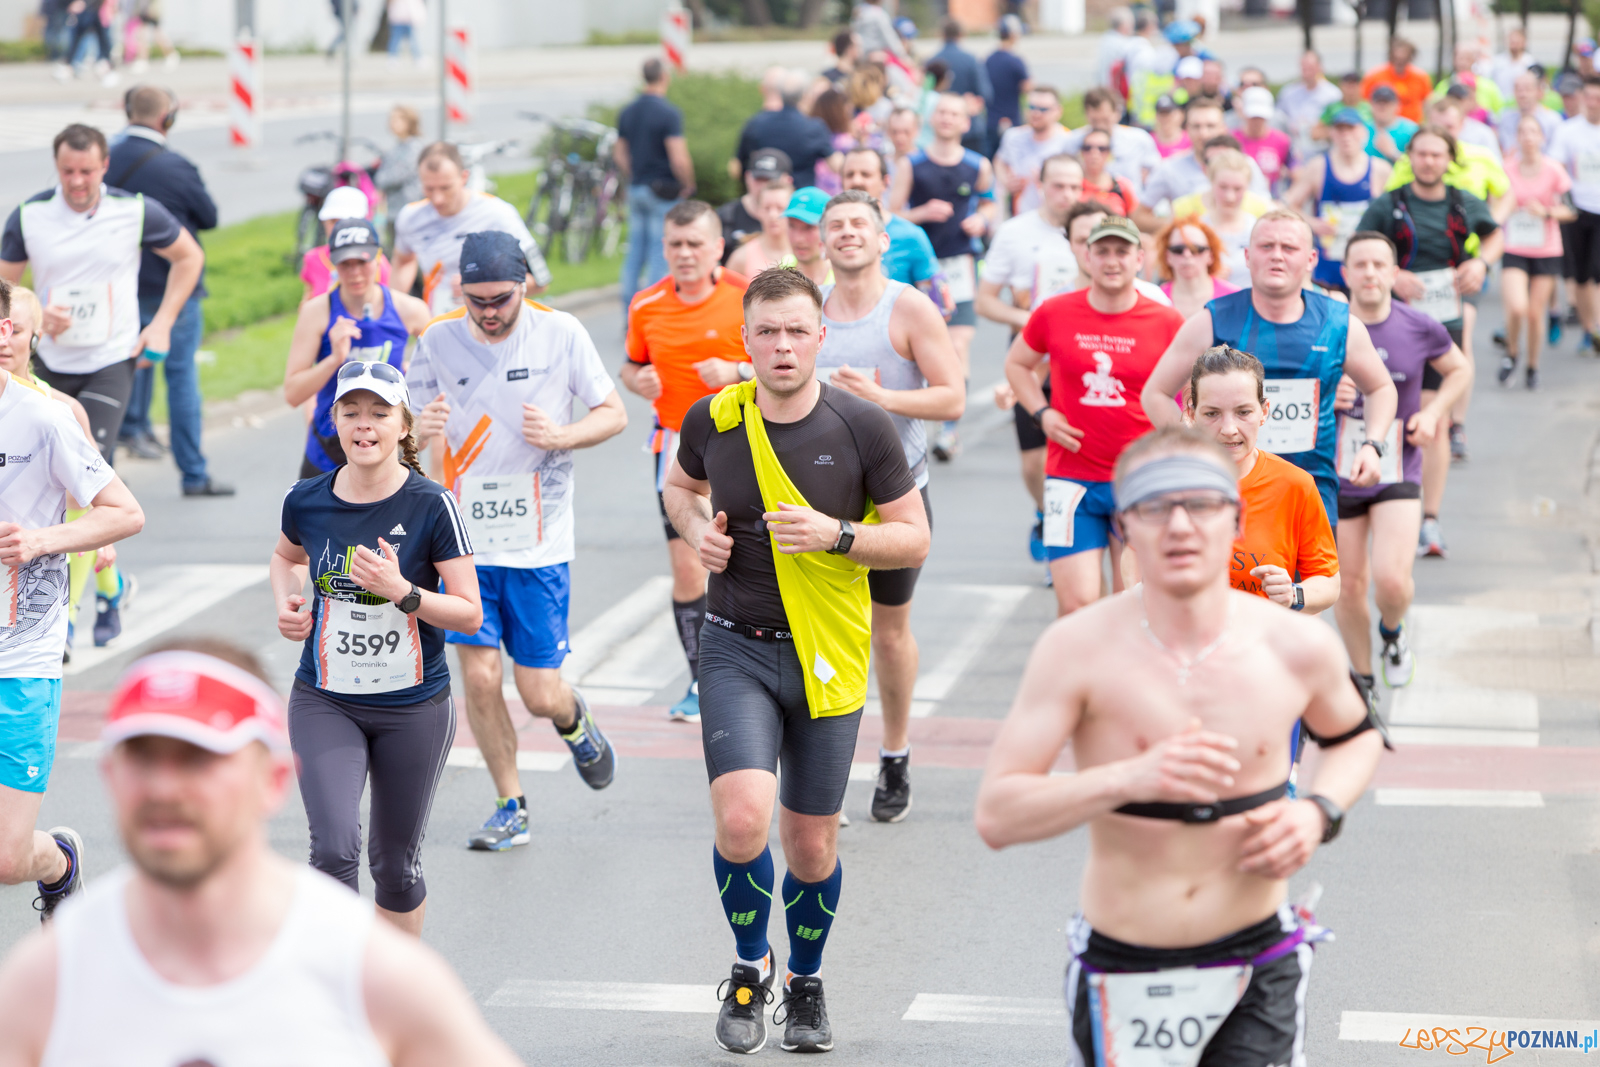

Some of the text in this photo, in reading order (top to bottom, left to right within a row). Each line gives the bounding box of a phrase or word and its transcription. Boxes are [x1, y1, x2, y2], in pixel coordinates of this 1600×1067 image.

[1267, 402, 1311, 420] 603
[472, 498, 527, 520] 8345
[336, 630, 400, 656] 3599
[351, 660, 388, 668] Dominika
